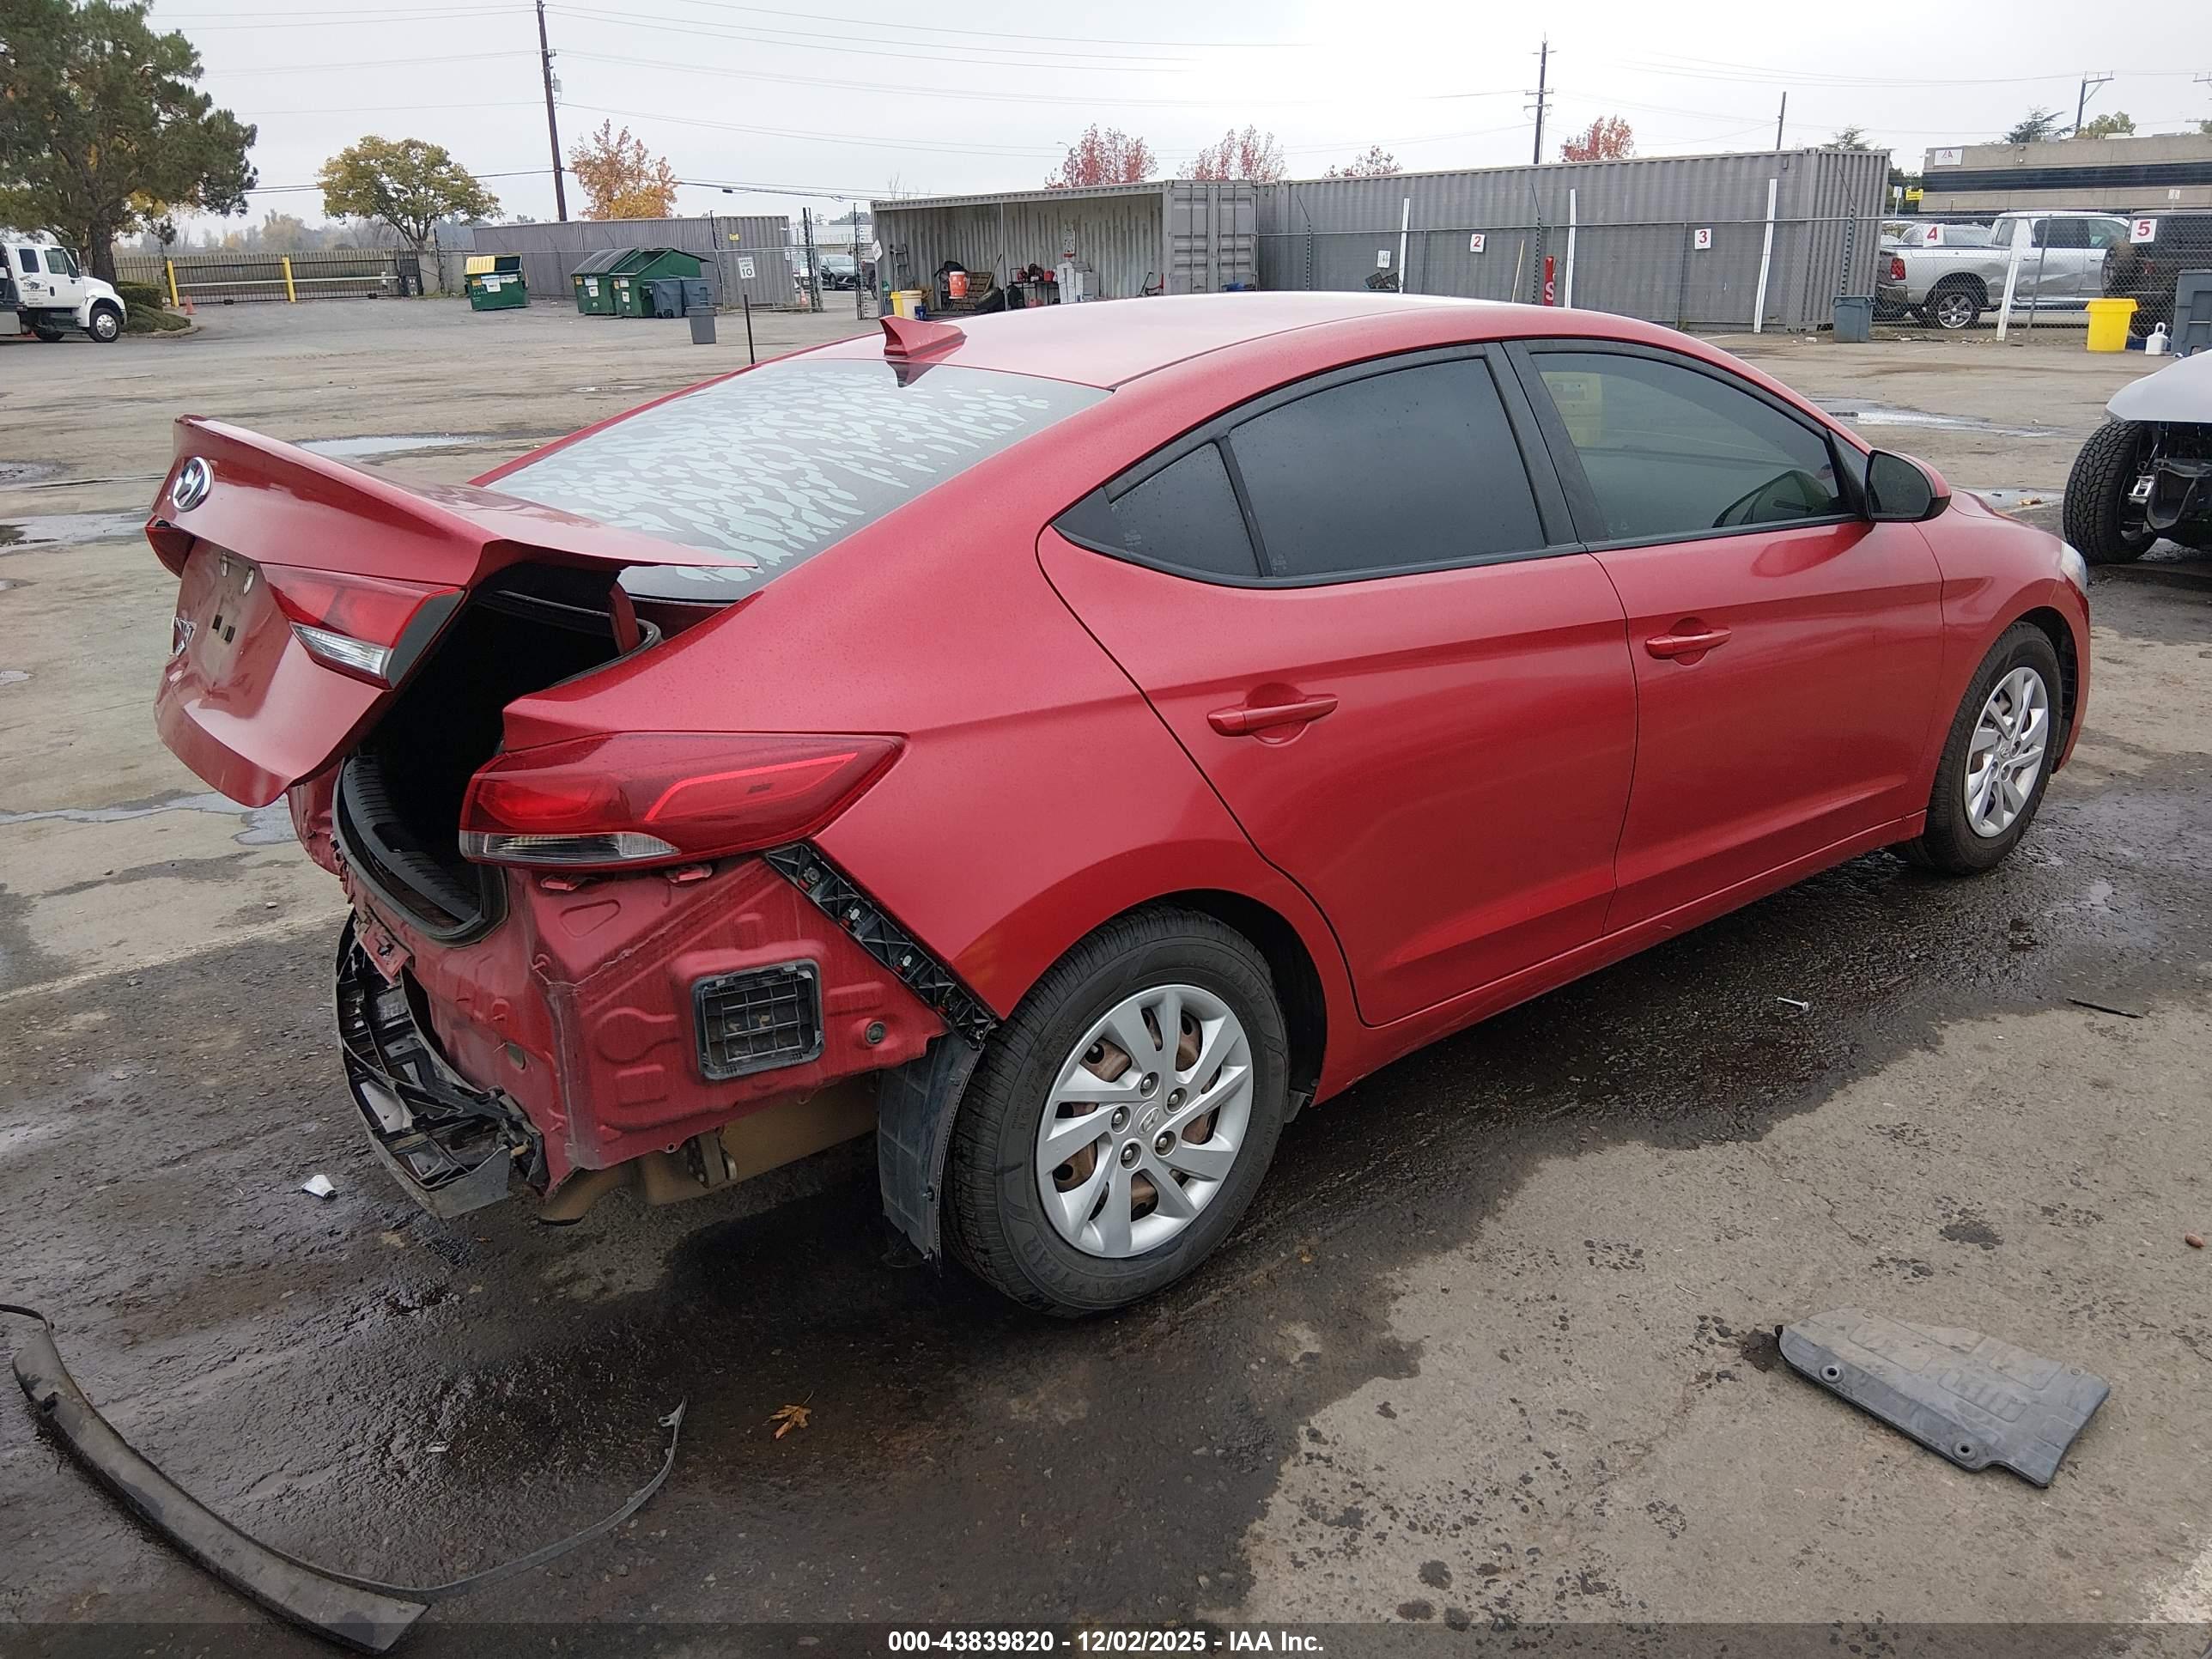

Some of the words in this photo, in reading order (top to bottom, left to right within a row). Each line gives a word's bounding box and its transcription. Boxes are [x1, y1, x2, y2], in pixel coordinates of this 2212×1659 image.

[1927, 226, 1938, 240] 4
[2137, 221, 2151, 236] 5
[1474, 235, 1481, 247] 2
[1698, 230, 1707, 244] 3
[742, 268, 752, 276] 10
